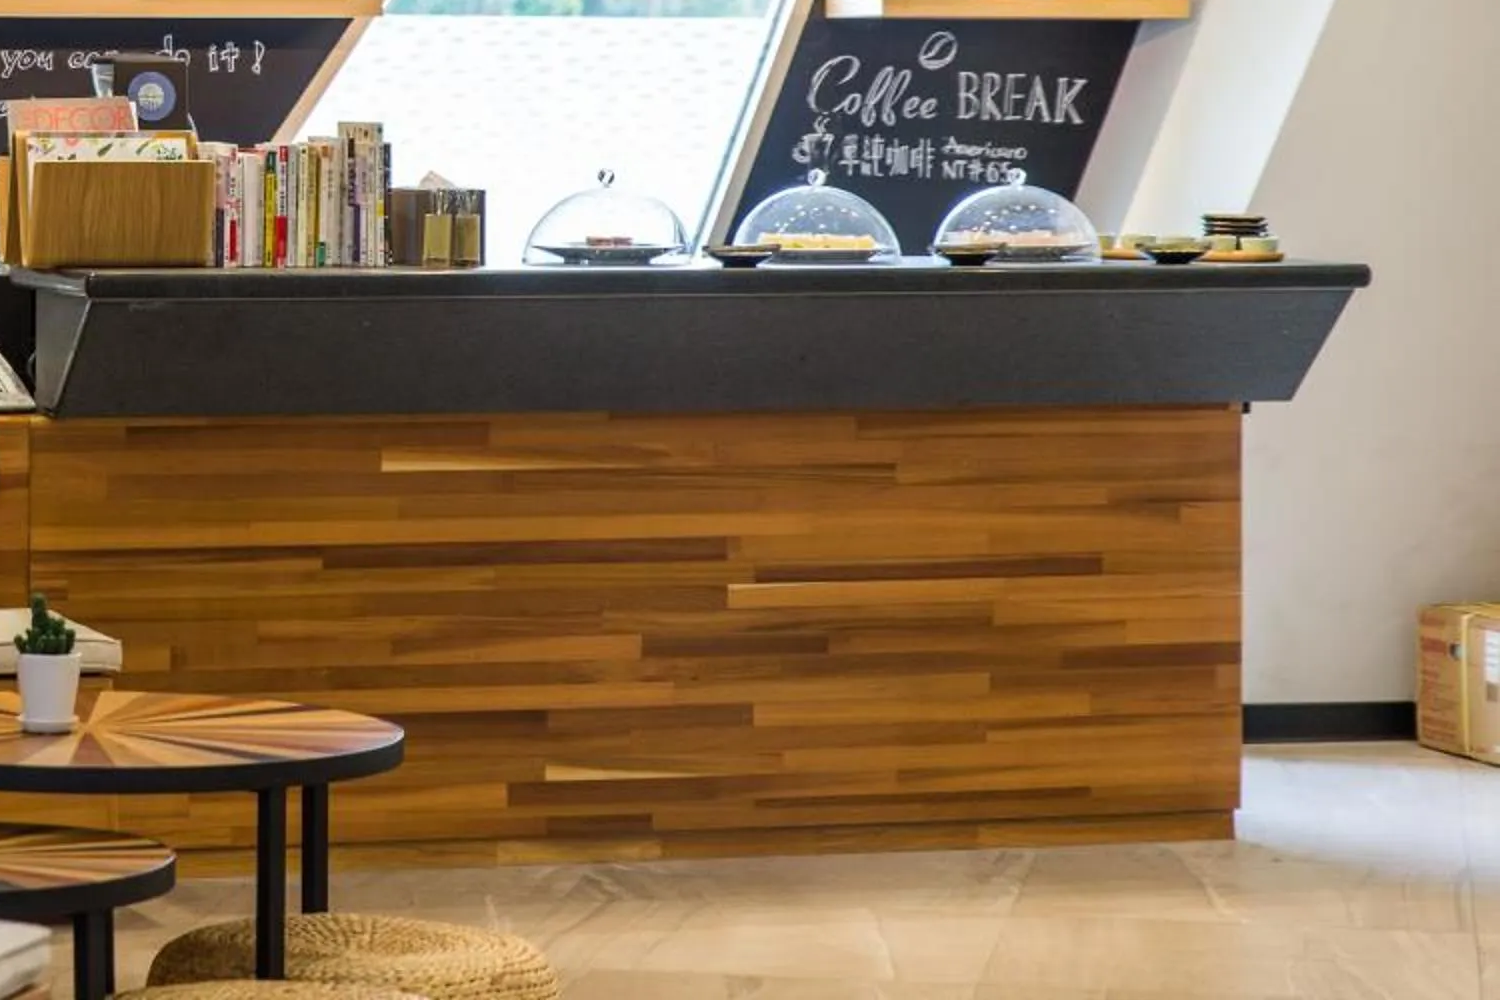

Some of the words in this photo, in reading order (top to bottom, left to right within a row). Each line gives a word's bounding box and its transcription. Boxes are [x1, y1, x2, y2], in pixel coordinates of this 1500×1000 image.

[1, 50, 53, 78] you
[68, 50, 119, 69] ca
[807, 55, 940, 127] Coffee
[957, 71, 1089, 124] BREAK
